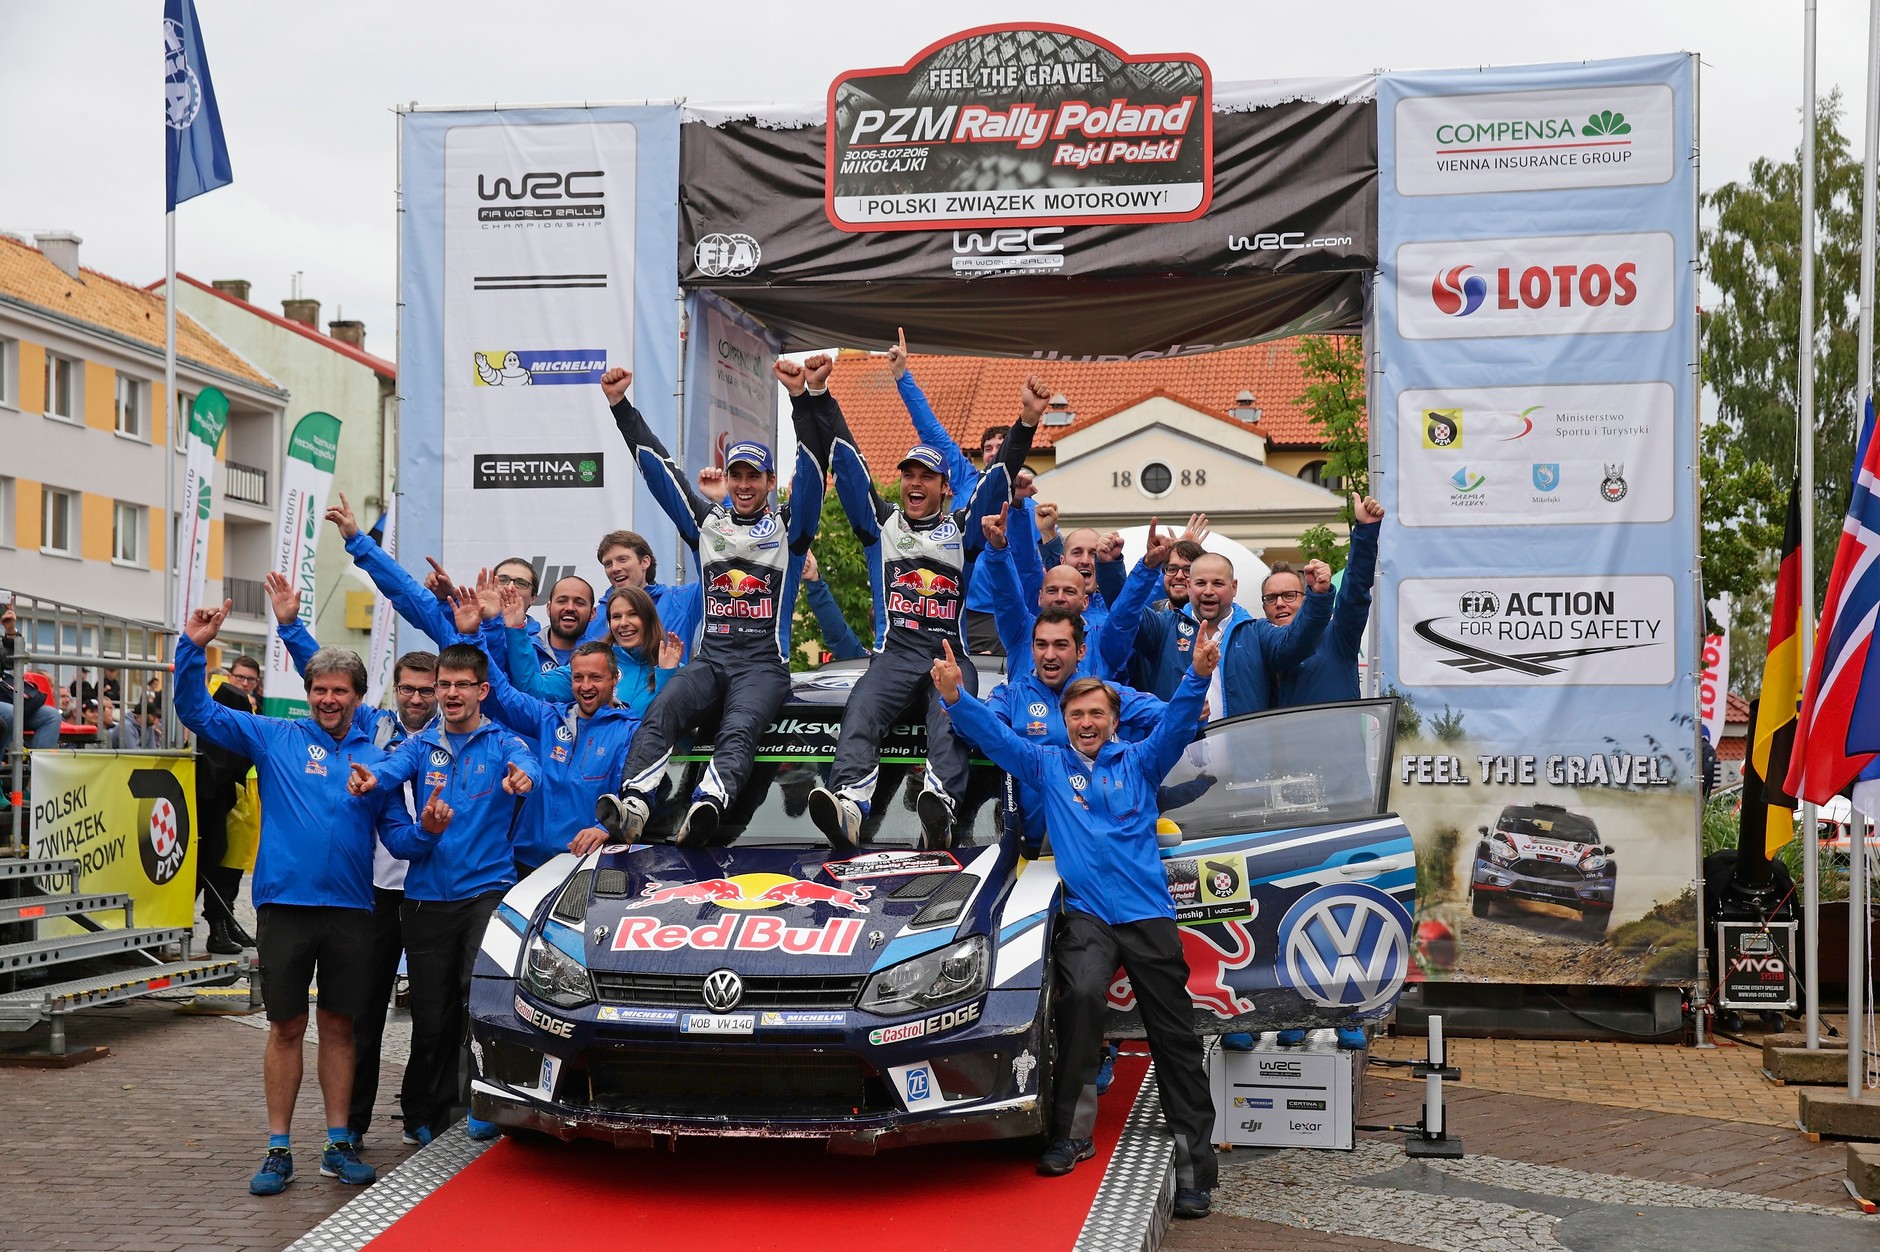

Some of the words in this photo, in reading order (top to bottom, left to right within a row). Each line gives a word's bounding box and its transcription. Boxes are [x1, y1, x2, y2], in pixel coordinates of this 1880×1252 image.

[929, 69, 971, 90] FEEL
[979, 66, 1017, 88] THE
[1025, 63, 1103, 85] GRAVEL
[848, 105, 957, 145] PZM
[955, 107, 1051, 145] Rally
[1055, 100, 1192, 136] Poland
[1436, 118, 1576, 145] COMPENSA
[844, 147, 929, 160] 30.06-3.07.2016
[1055, 143, 1105, 168] Rajd
[1109, 140, 1178, 162] Polski
[1437, 158, 1490, 172] VIENNA
[1494, 153, 1577, 169] INSURANCE
[1582, 151, 1632, 164] GROUP
[840, 157, 926, 174] MIKOŁAJKI
[478, 171, 605, 200] WRC
[481, 210, 501, 218] FIA
[504, 209, 552, 217] WORLD
[556, 208, 602, 216] RALLY
[868, 197, 937, 215] POLSKI
[946, 195, 1034, 216] ZWIĄZEK
[1044, 191, 1161, 211] MOTOROWY
[481, 222, 602, 230] CHAMPIONSHIP
[952, 226, 1065, 254] WRC
[699, 242, 755, 269] FIA
[955, 268, 1060, 276] CHAMPIONSHIP
[1497, 262, 1638, 311] LOTOS
[530, 360, 606, 371] MICHELIN
[1556, 412, 1625, 422] Ministerstwo
[1556, 427, 1590, 437] Sportu
[1601, 425, 1650, 437] Turystyki
[1434, 438, 1452, 447] PZM
[480, 461, 576, 474] CERTINA
[1112, 471, 1132, 488] 18
[1181, 469, 1206, 486] 88
[707, 596, 735, 617] Red
[736, 598, 772, 619] Bull
[888, 592, 925, 616] Red
[926, 599, 957, 620] Bull
[1461, 597, 1496, 613] FIA
[1505, 591, 1614, 616] ACTION
[1460, 621, 1493, 635] FOR
[1499, 621, 1563, 640] ROAD
[1570, 620, 1662, 639] SAFETY
[1701, 632, 1722, 720] LOTOS
[786, 745, 819, 754] Rally
[1402, 755, 1469, 784] FEEL
[1478, 755, 1535, 783] THE
[1546, 754, 1668, 785] GRAVEL
[35, 785, 88, 830] POLSKI
[37, 811, 106, 859] ZWIĄZEK
[1539, 845, 1576, 856] LOTOS
[156, 842, 184, 881] PZM
[1168, 880, 1197, 893] oland
[1215, 889, 1234, 897] PZM
[612, 915, 737, 951] Red
[737, 917, 863, 955] Bull
[533, 1010, 576, 1038] EDGE
[622, 1010, 677, 1021] MICHELIN
[690, 1018, 711, 1029] WOB
[717, 1018, 732, 1029] VW
[786, 1012, 845, 1023] MICHELIN
[883, 1022, 923, 1043] Castrol
[924, 1002, 980, 1035] EDGE
[1260, 1061, 1301, 1071] WRC
[909, 1075, 926, 1095] ZF
[1290, 1120, 1321, 1131] Lexar
